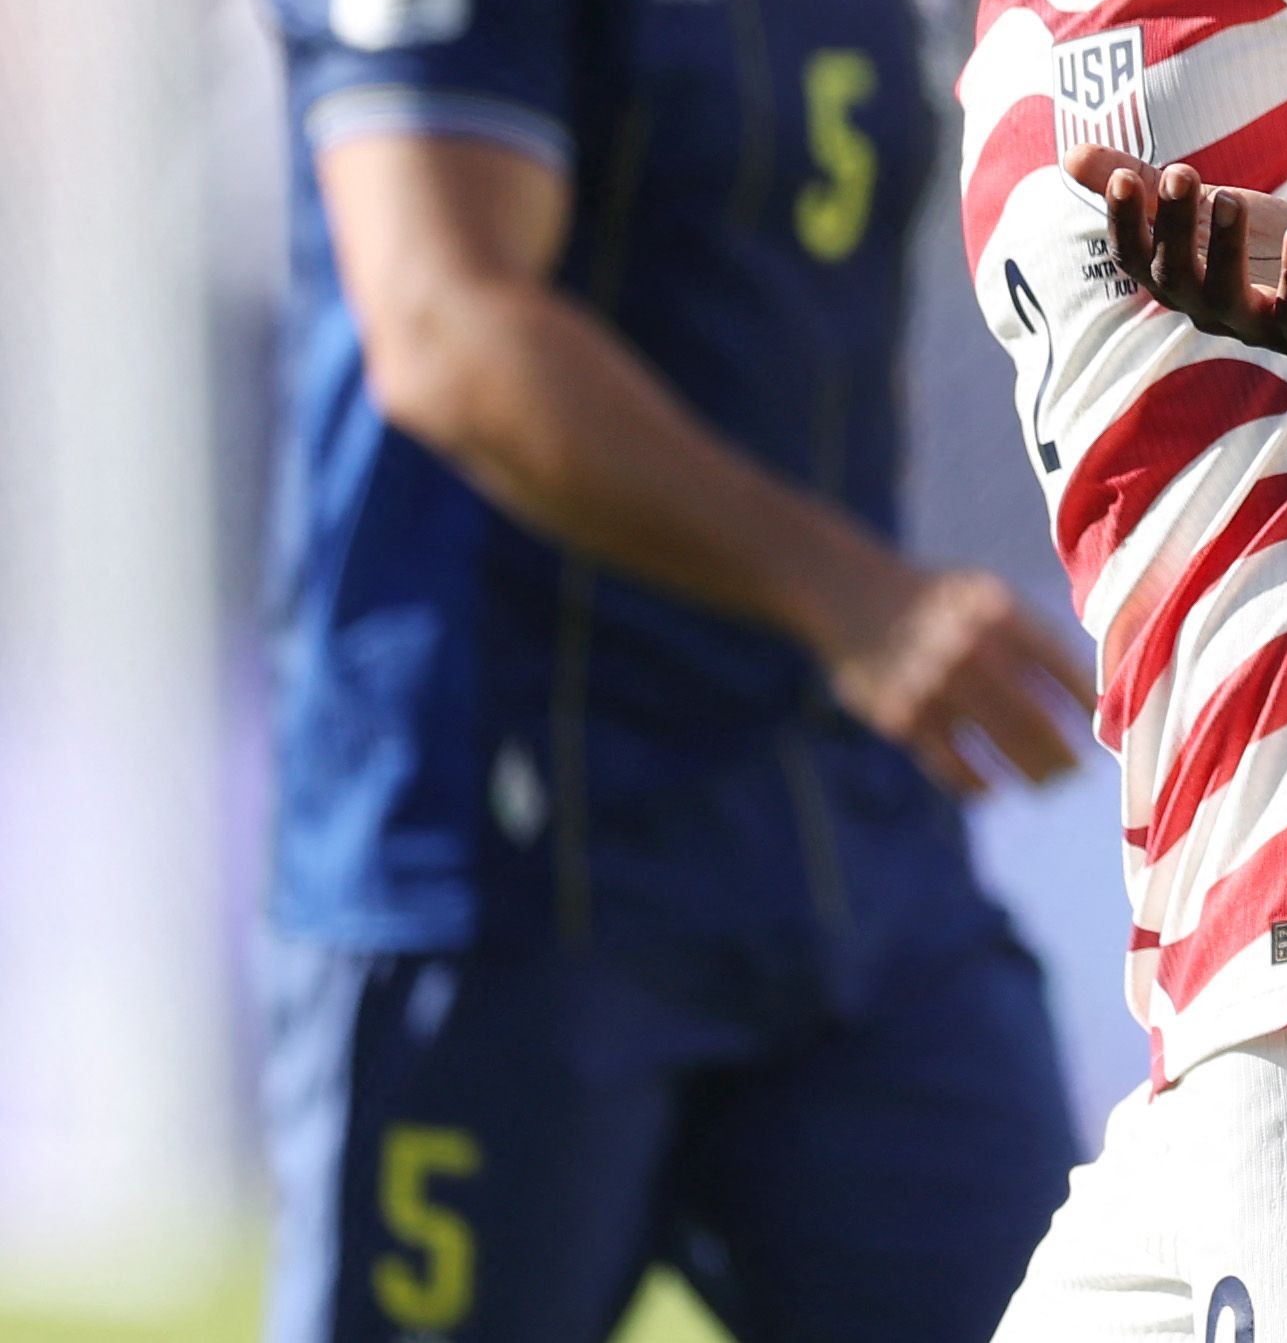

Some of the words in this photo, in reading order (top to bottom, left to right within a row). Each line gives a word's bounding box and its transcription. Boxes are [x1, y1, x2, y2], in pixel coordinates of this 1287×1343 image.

[1059, 40, 1135, 111] USA
[795, 48, 878, 263] 5
[1087, 239, 1108, 256] USA
[1082, 261, 1117, 281] SANTA
[1104, 282, 1110, 300] 1
[373, 1123, 482, 1328] 5
